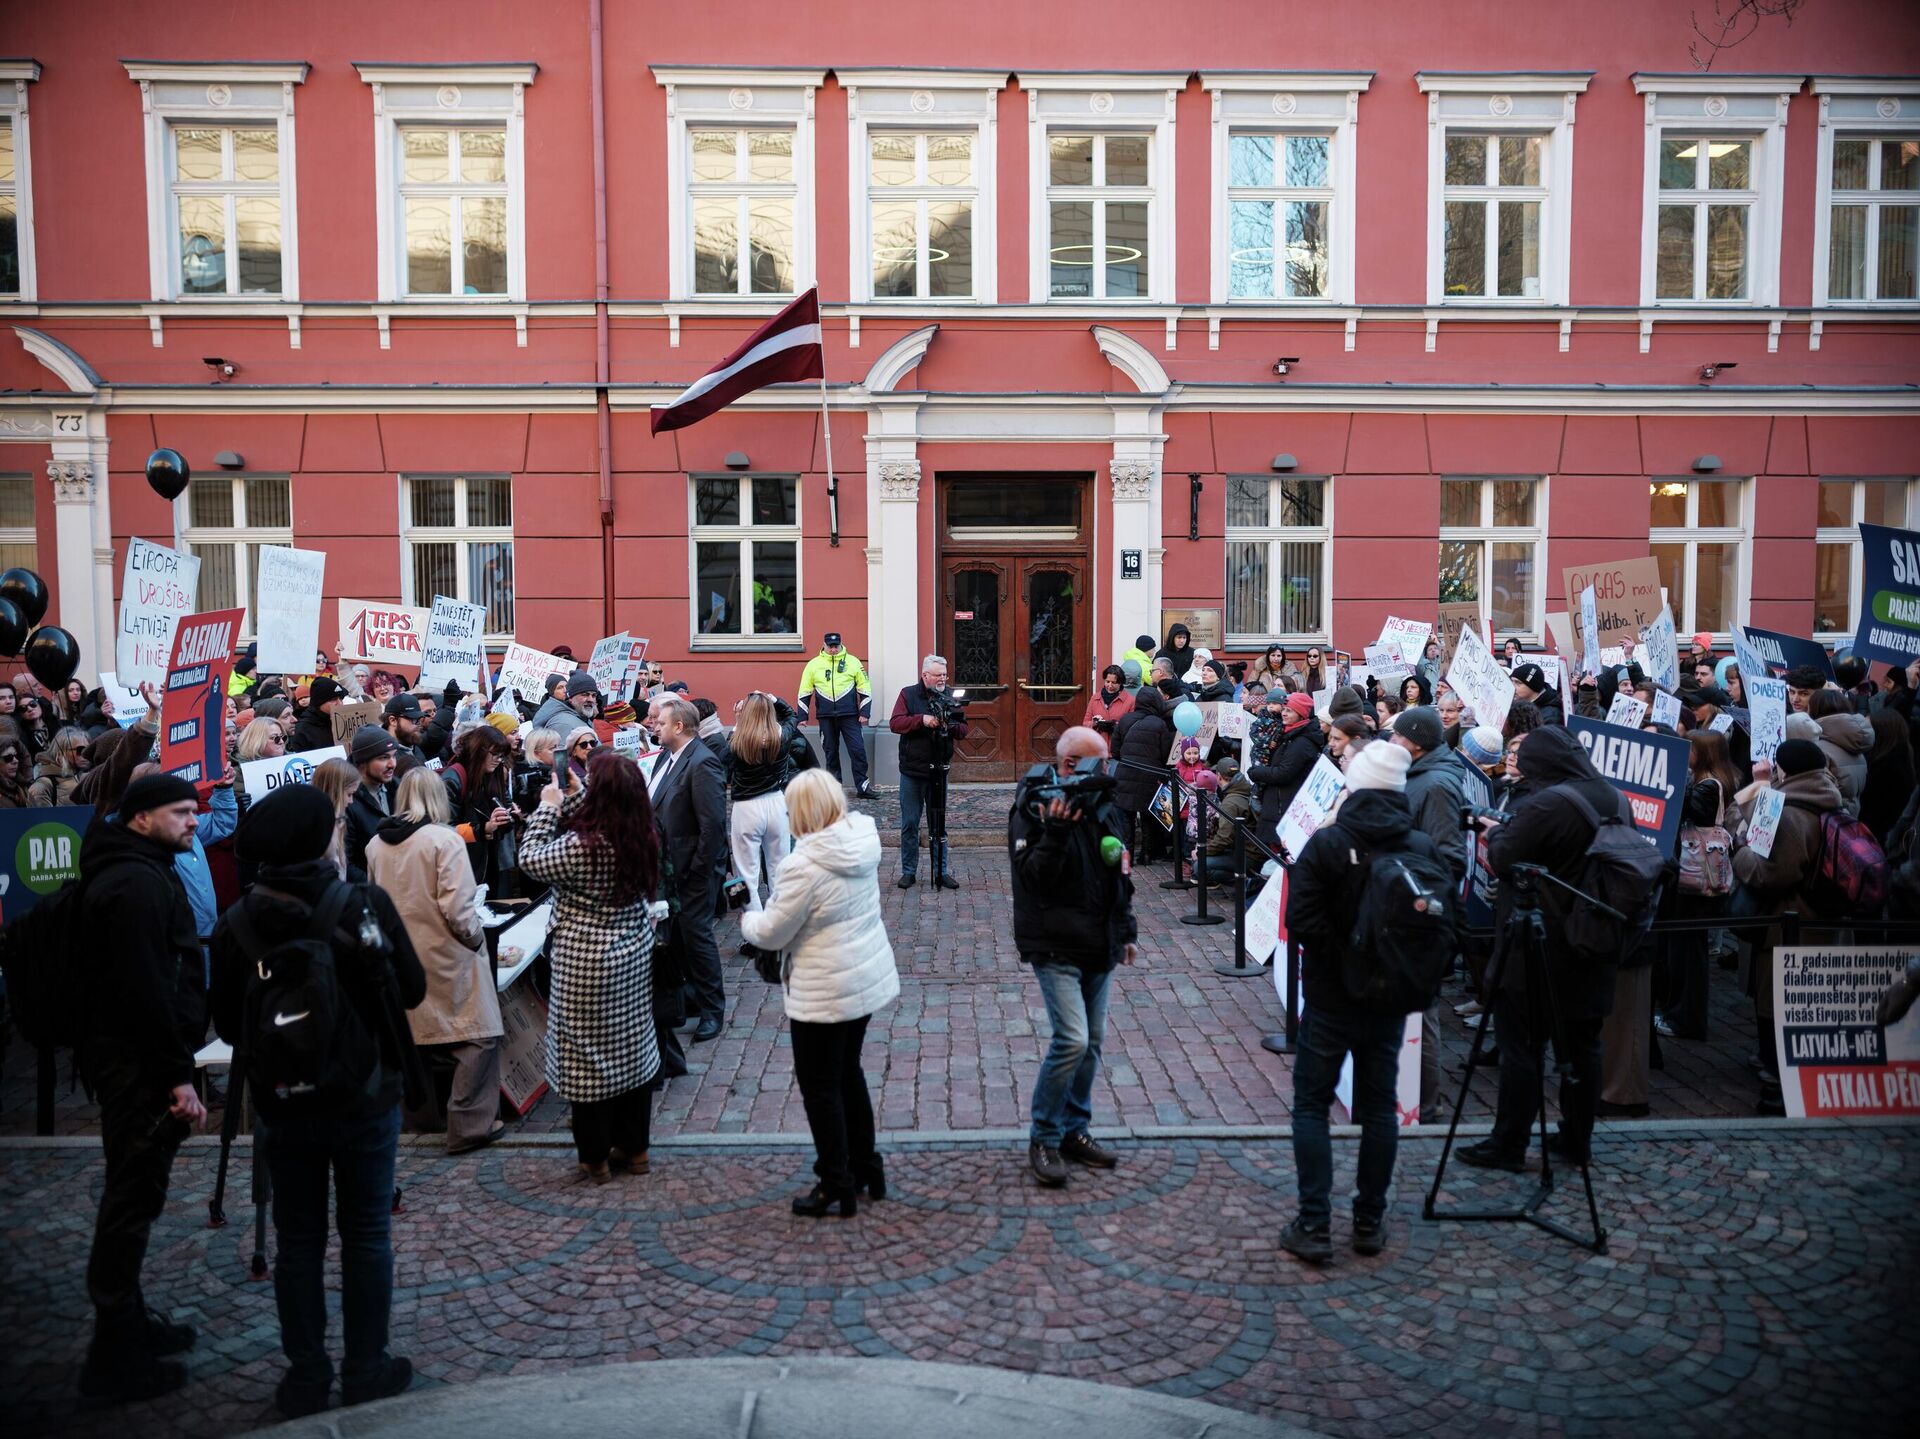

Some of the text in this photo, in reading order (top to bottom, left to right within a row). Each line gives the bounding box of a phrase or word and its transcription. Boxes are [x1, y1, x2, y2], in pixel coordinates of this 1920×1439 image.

[56, 415, 82, 432] 73
[1125, 556, 1138, 568] 16
[1890, 539, 1920, 587] SA
[139, 578, 191, 610] DROŠĪBA
[435, 603, 473, 621] INVESTĒT
[177, 620, 232, 667] SAEIMA,
[1869, 627, 1907, 651] GLIKOZES
[1578, 730, 1675, 799] SAEIMA,
[266, 763, 318, 790] DIABĒ
[29, 836, 72, 870] PAR
[31, 874, 54, 882] DARBA
[1783, 953, 1800, 969] 21.
[1801, 952, 1851, 973] gadsimta
[1783, 970, 1892, 990] diabēta aprūpei tiek
[1784, 988, 1857, 1008] kompensētas
[1785, 1007, 1814, 1023] visās
[1816, 1006, 1857, 1026] Eiropas
[1817, 1072, 1882, 1109] ATKAL
